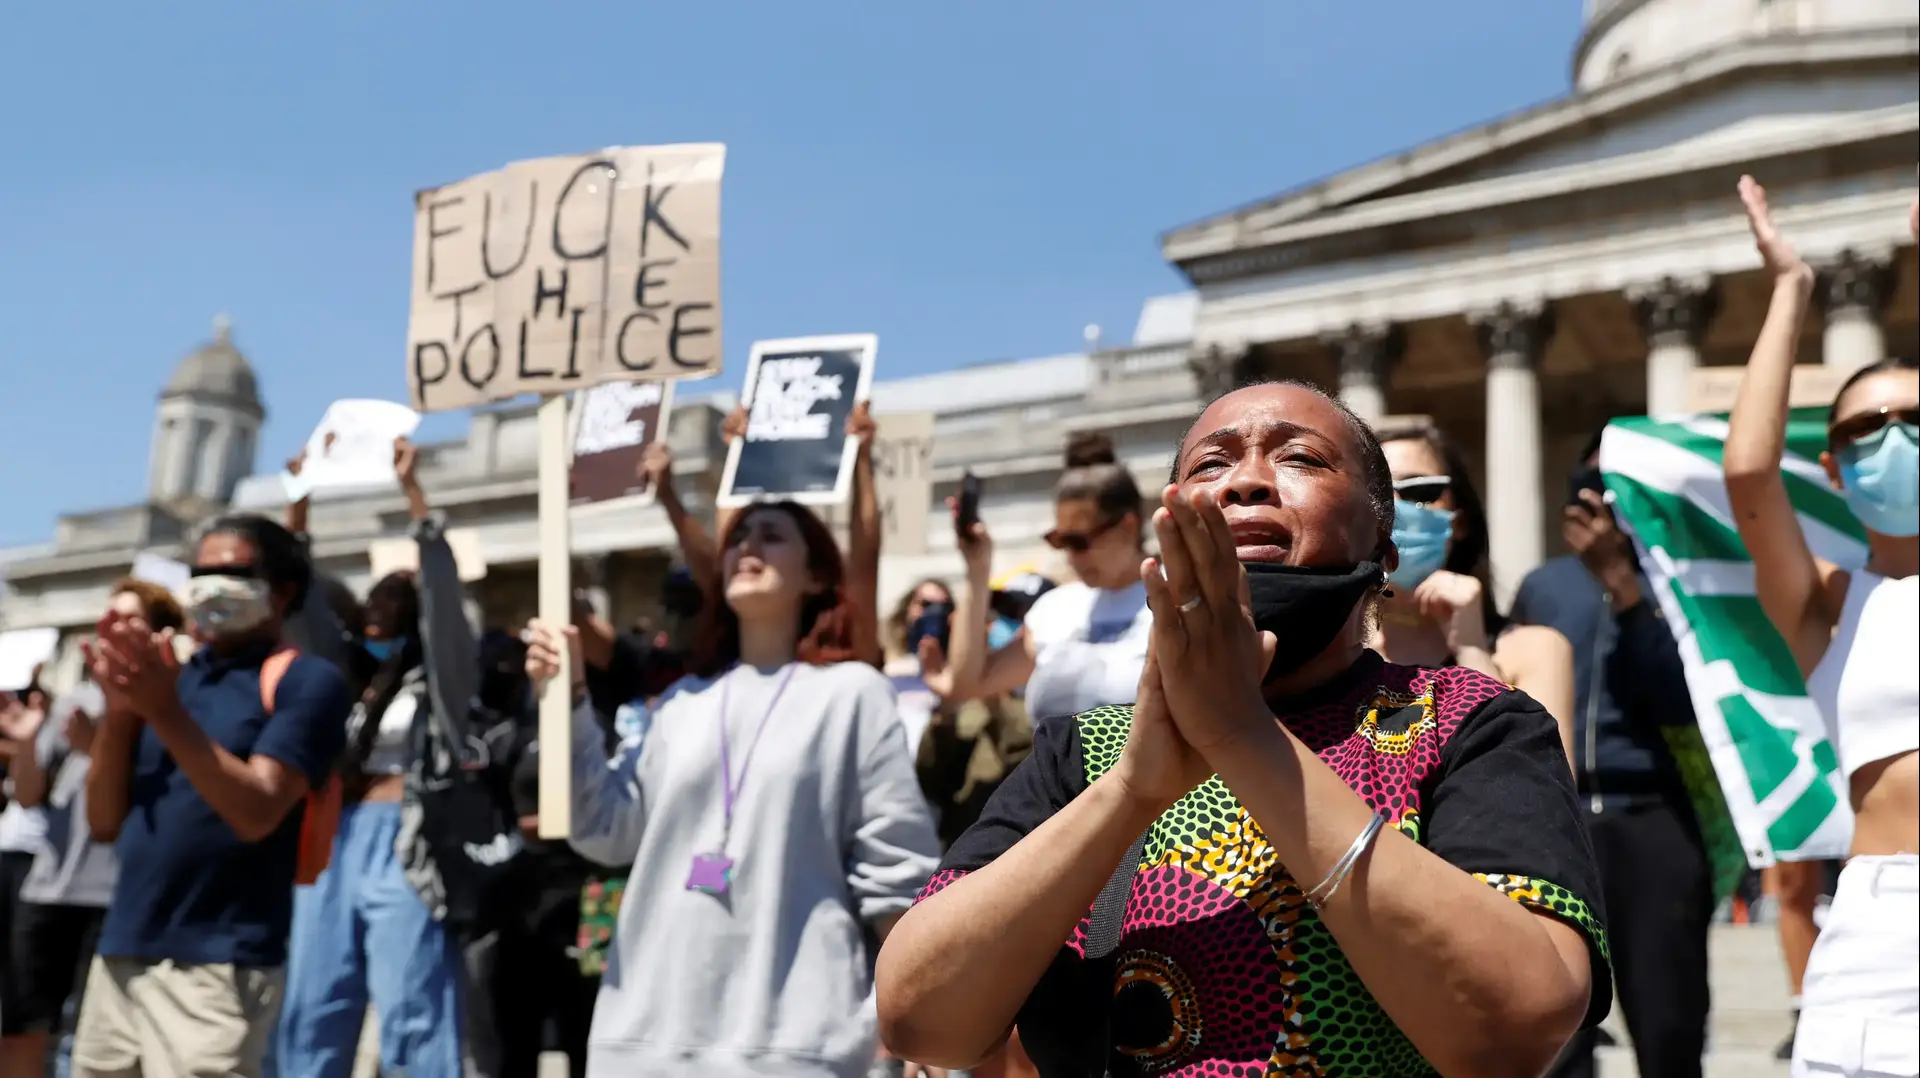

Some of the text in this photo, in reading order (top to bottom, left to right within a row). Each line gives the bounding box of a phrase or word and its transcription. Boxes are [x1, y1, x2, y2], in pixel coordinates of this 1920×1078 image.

[428, 160, 690, 293] FUCK
[433, 258, 678, 342] THE
[414, 303, 714, 404] POLICE
